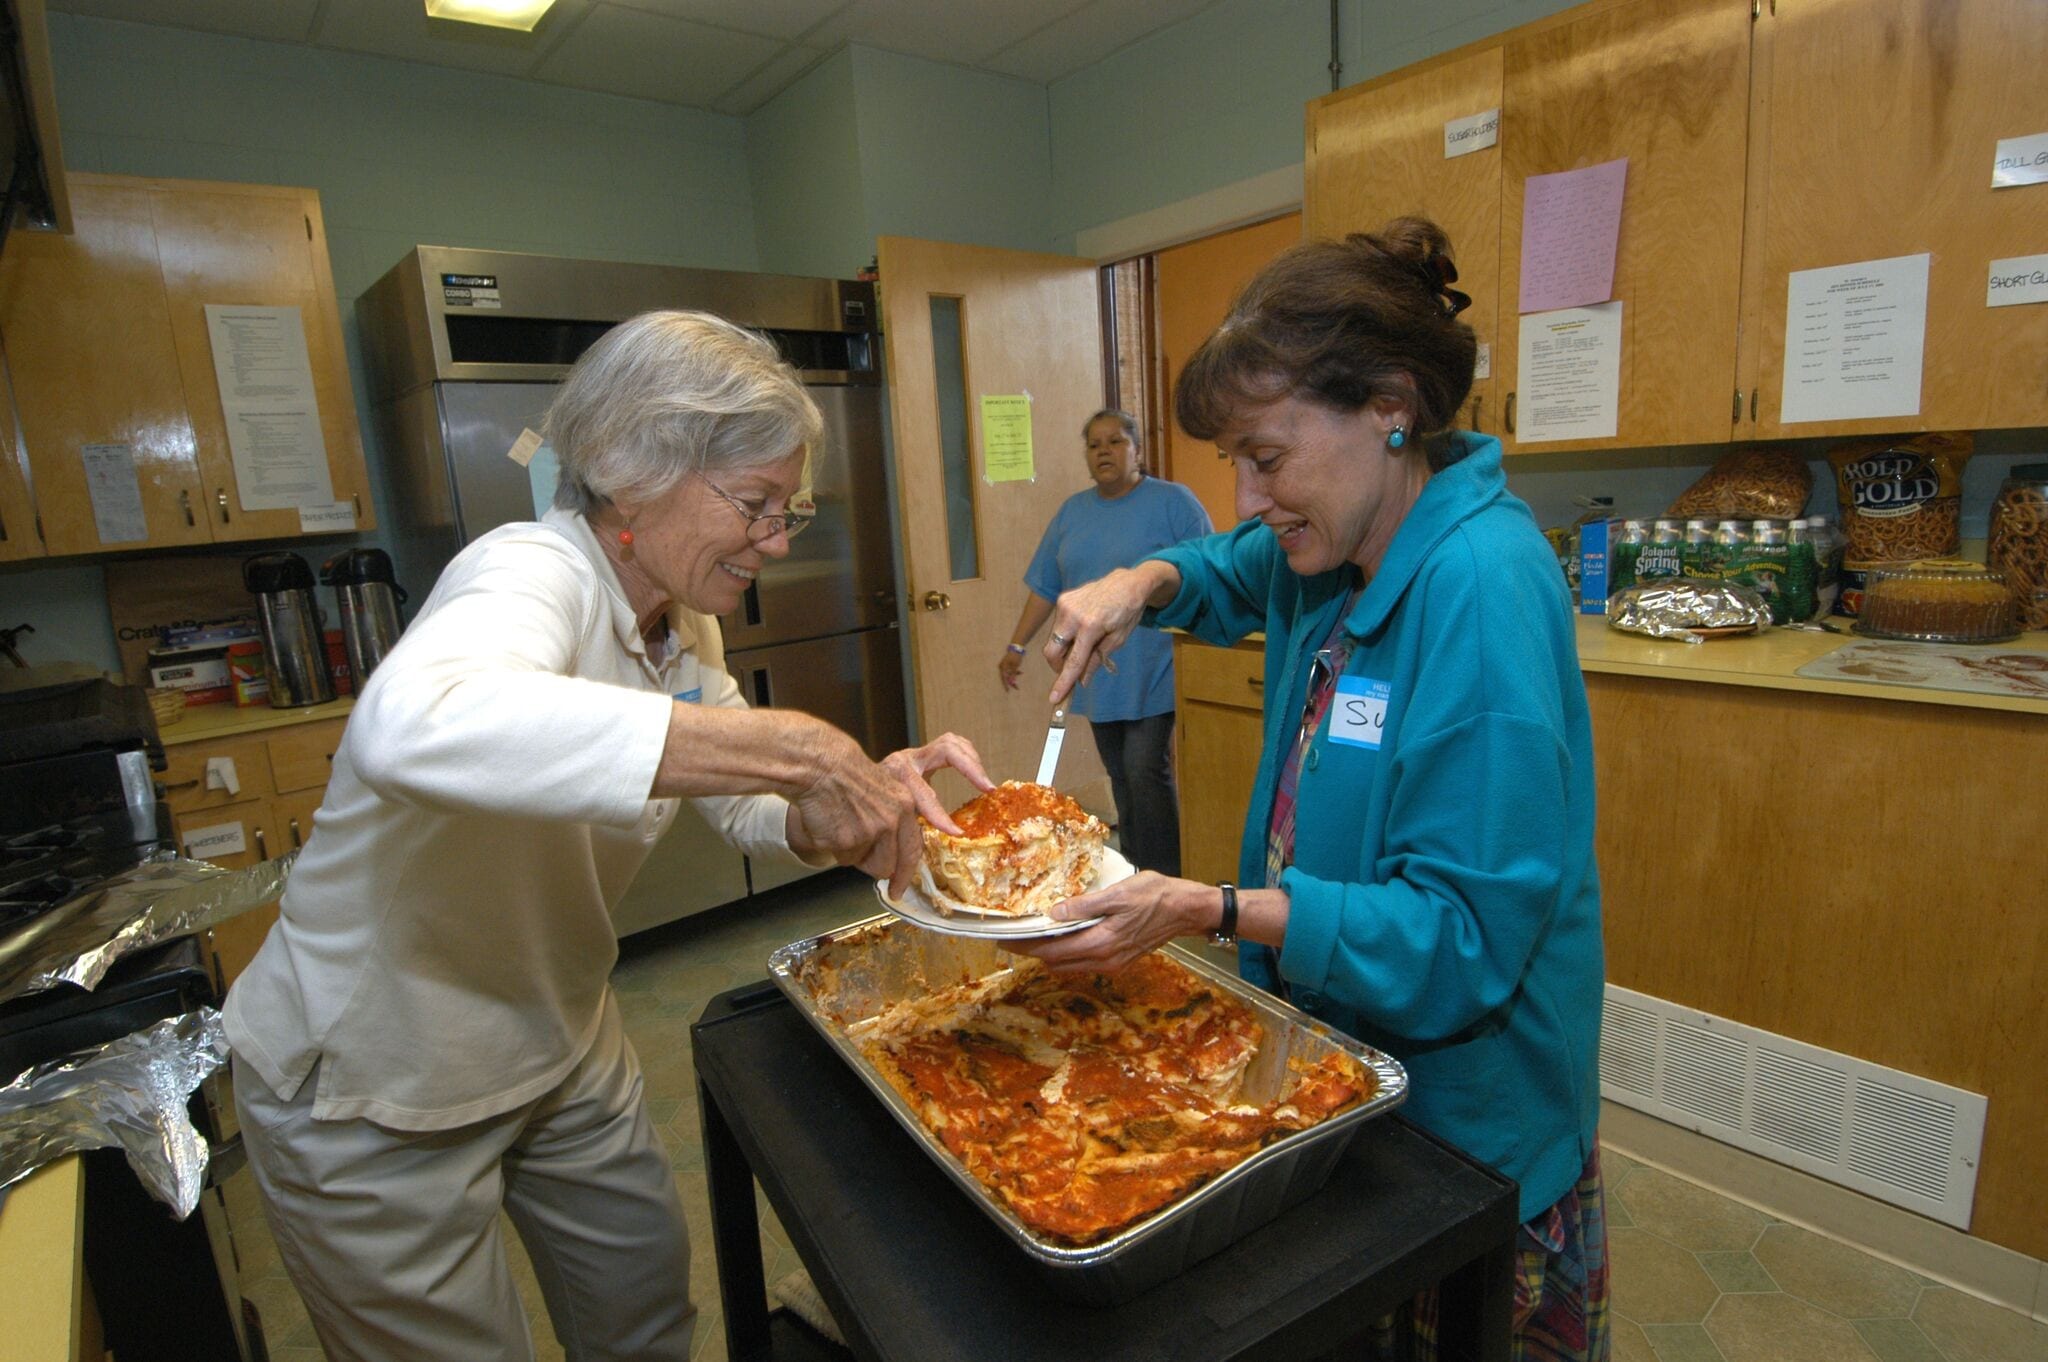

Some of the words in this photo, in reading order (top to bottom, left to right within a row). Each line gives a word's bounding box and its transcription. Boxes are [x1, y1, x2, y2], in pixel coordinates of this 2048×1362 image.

[1997, 156, 2032, 170] TALL
[2034, 151, 2048, 166] G
[1990, 273, 2031, 289] SHORT
[1844, 458, 1913, 480] ROLD
[1852, 477, 1938, 505] GOLD
[1641, 545, 1678, 557] Poland
[1634, 555, 1680, 576] Spring
[1683, 565, 1720, 580] Choose
[1721, 567, 1743, 579] Your
